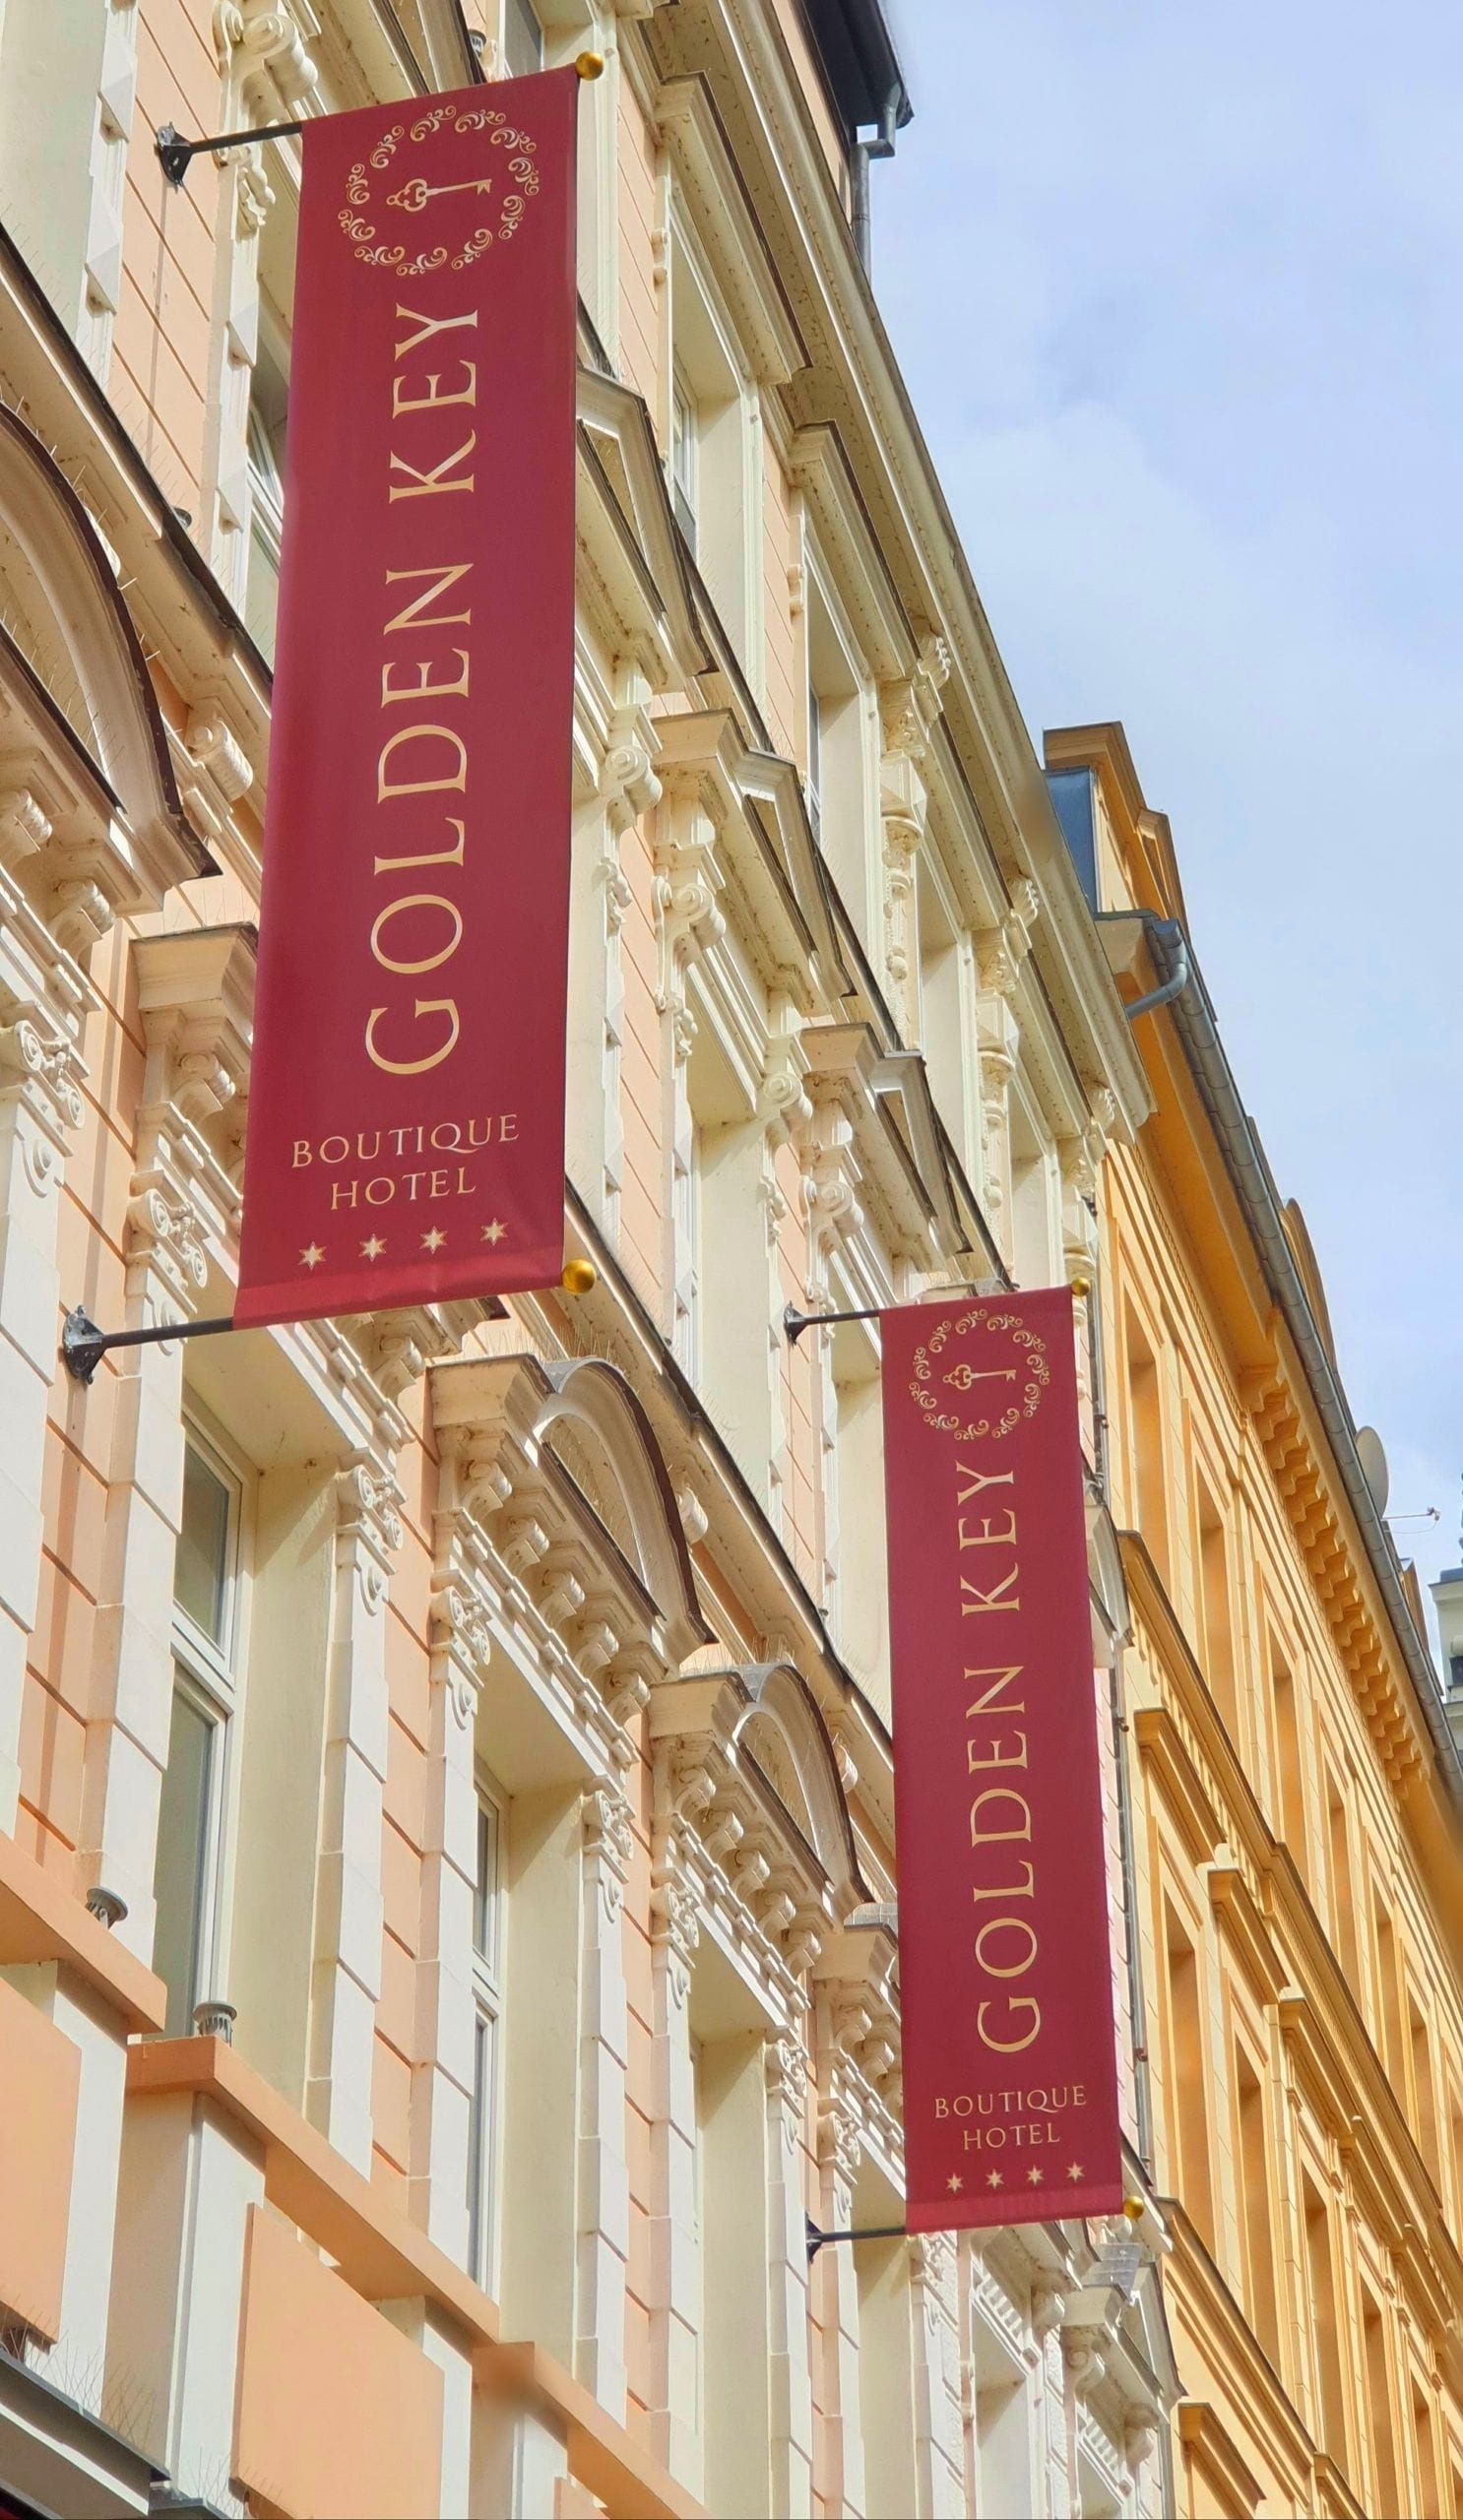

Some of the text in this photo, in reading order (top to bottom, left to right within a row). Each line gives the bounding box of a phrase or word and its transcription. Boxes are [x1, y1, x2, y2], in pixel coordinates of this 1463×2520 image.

[364, 303, 478, 1075] GOLDEN KEY
[291, 1113, 520, 1168] BOUTIQUE
[330, 1166, 477, 1211] HOTEL
[955, 1461, 1041, 2052] GOLDEN KEY
[934, 2085, 1087, 2119] BOUTIQUE
[963, 2122, 1060, 2151] HOTEL
